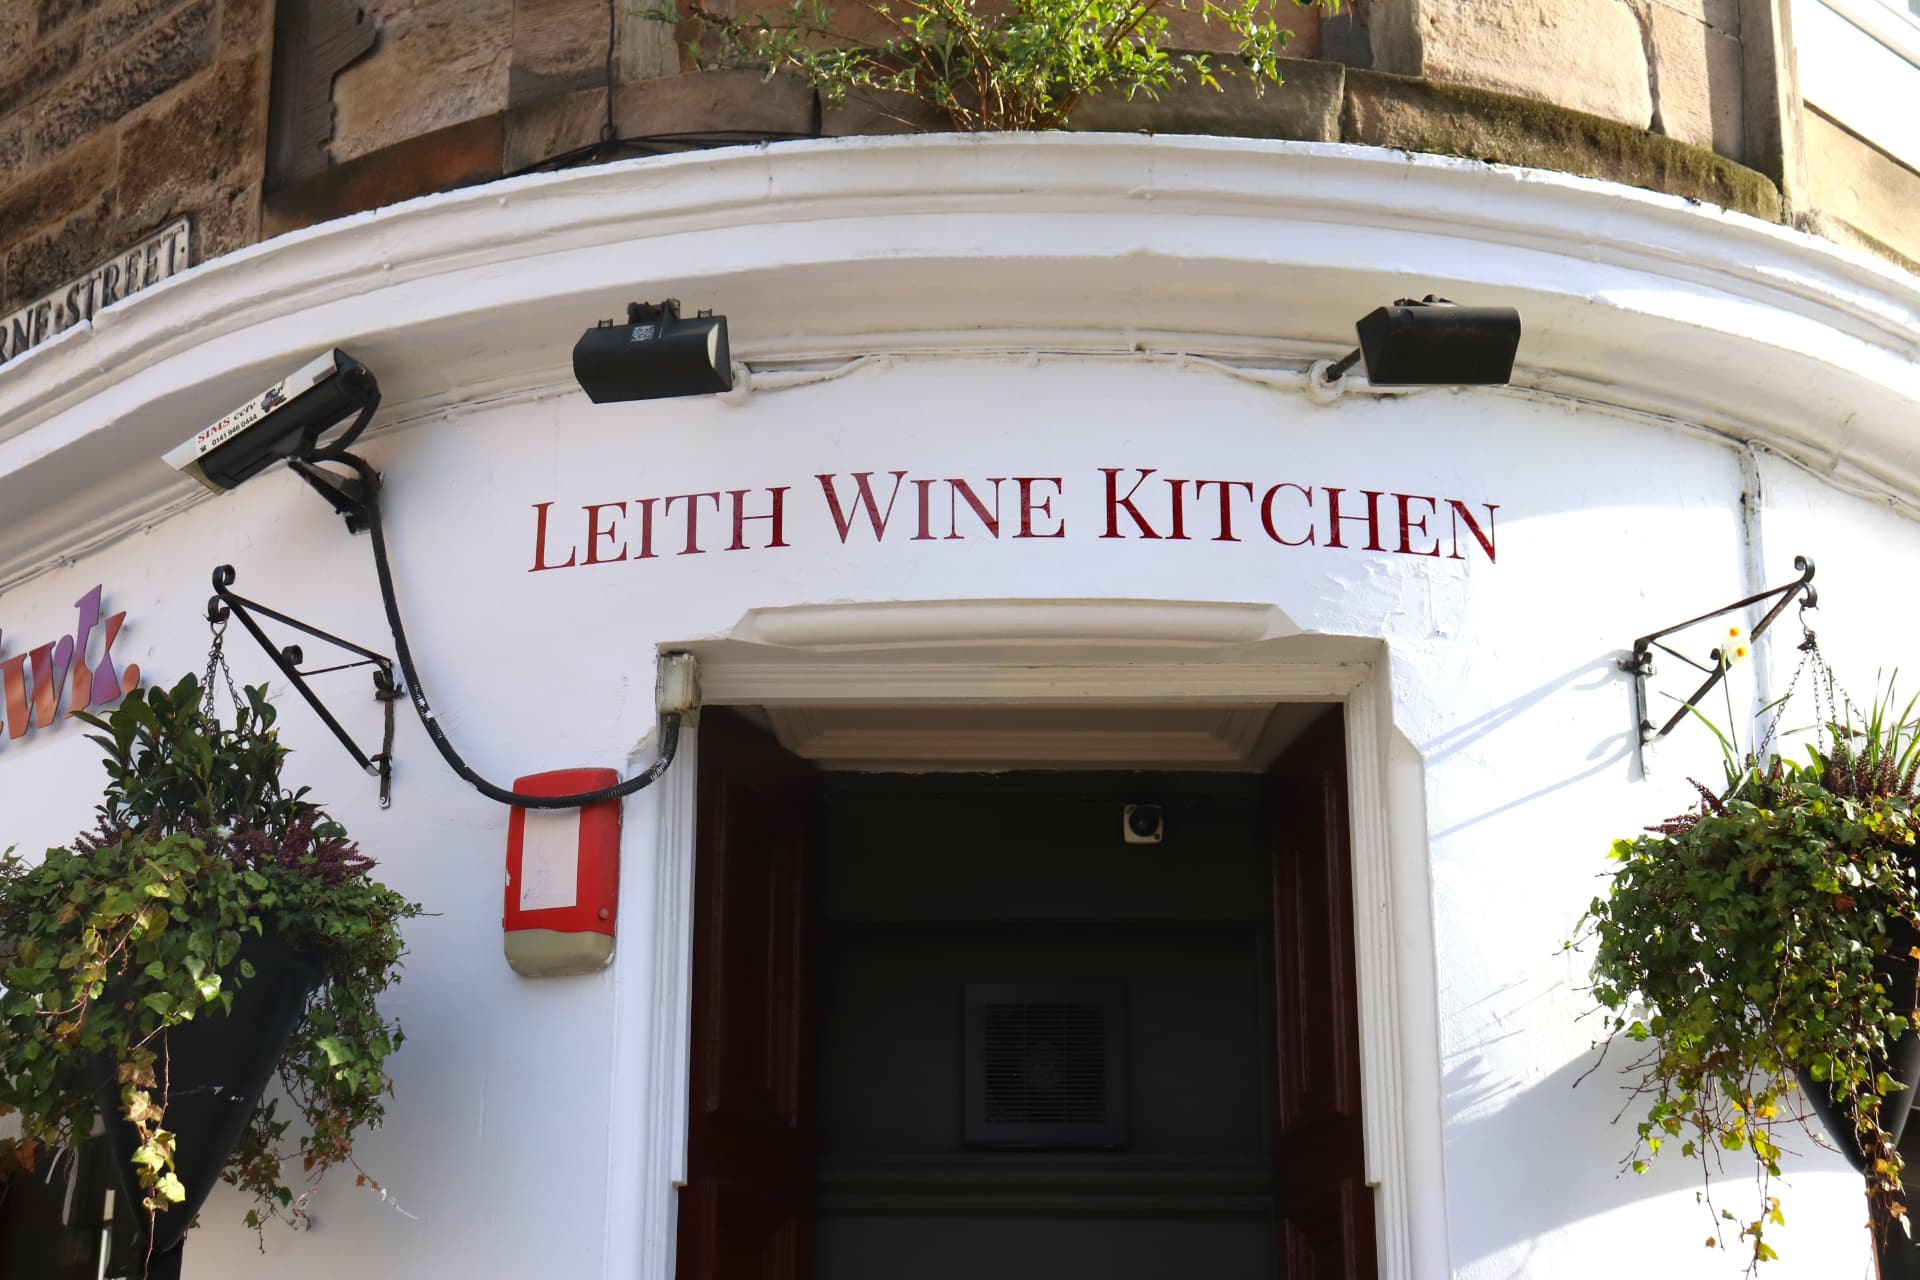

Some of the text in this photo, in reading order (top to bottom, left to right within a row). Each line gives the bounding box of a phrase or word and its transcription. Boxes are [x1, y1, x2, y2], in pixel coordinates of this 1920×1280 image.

[64, 223, 185, 329] STREET
[198, 417, 231, 443] SIMS
[212, 433, 227, 446] 0141
[528, 468, 1500, 573] LEITH WINE KITCHEN
